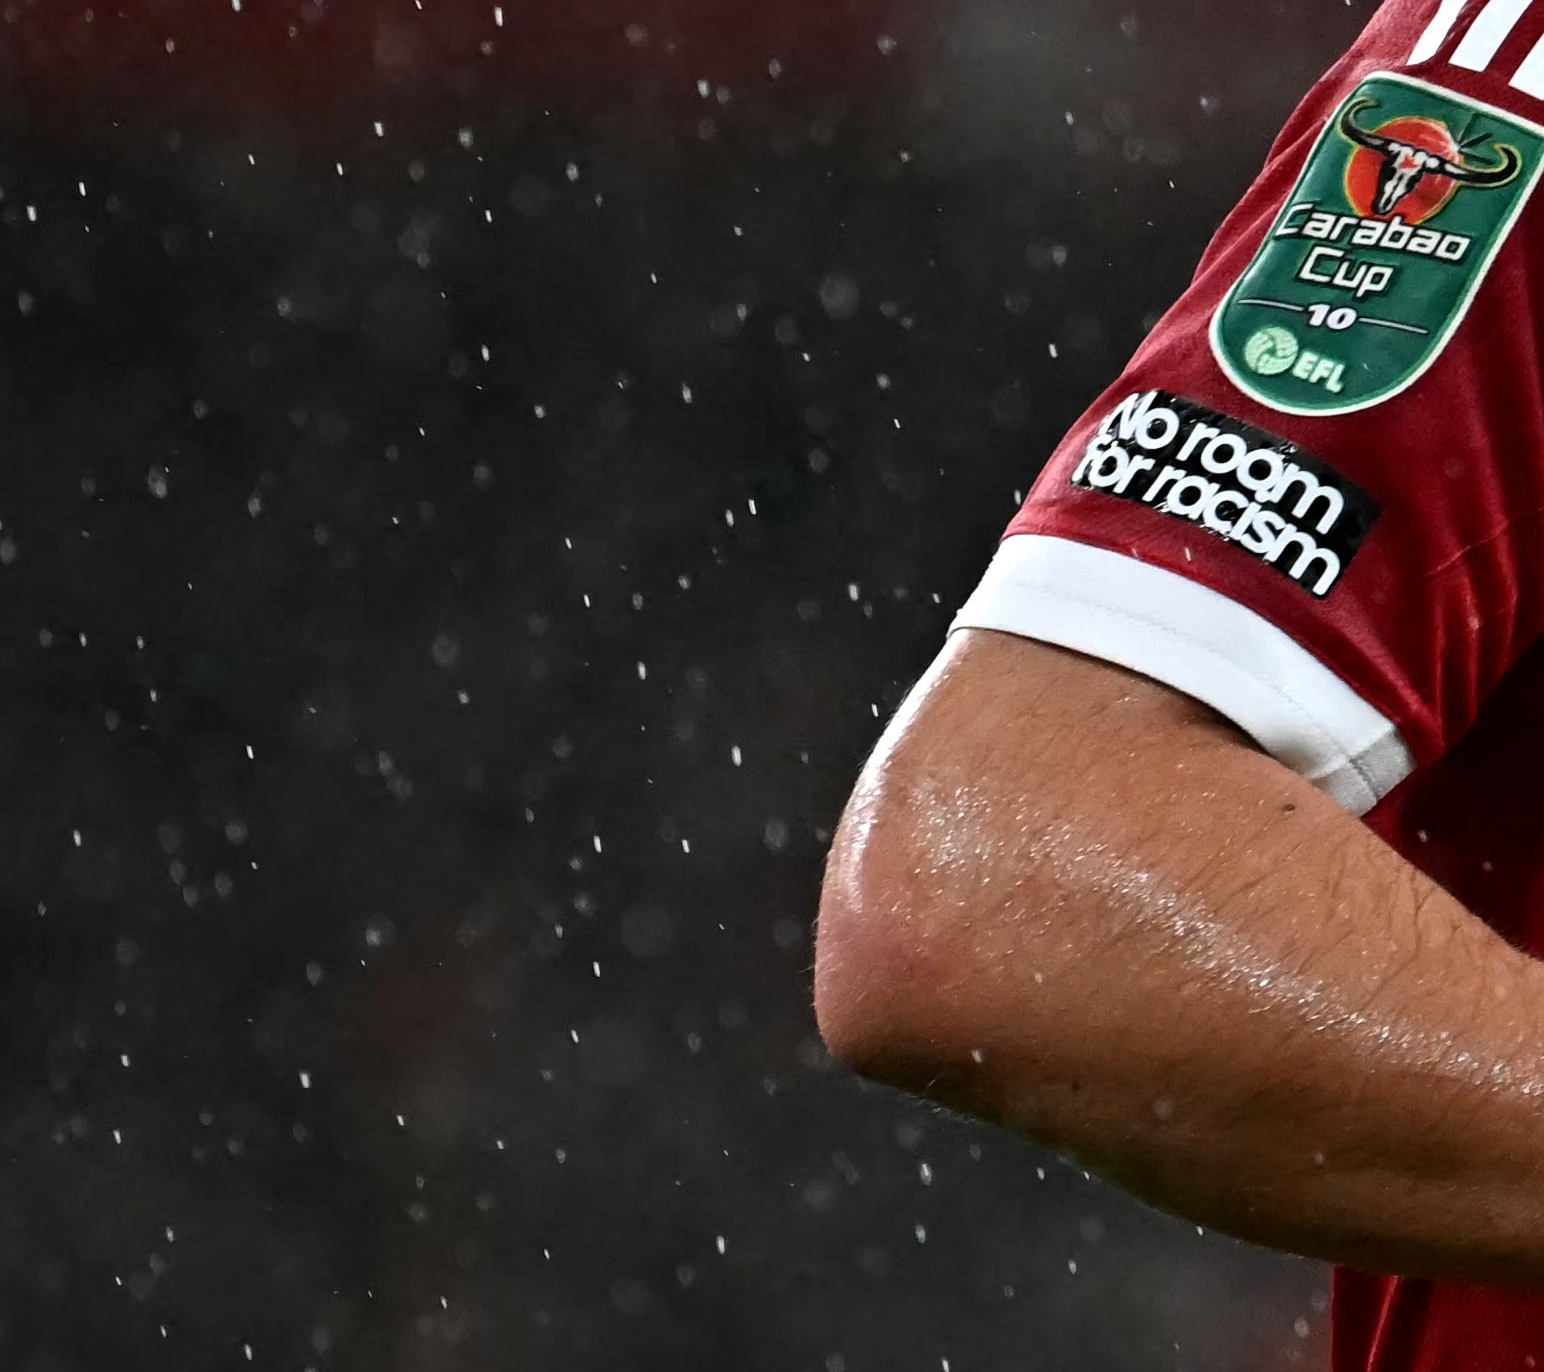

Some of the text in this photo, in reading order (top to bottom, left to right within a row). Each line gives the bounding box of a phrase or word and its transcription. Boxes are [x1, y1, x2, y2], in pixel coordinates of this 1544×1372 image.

[1276, 202, 1471, 261] Carabao
[1298, 245, 1394, 298] Cup
[1307, 303, 1357, 330] 10
[1291, 350, 1346, 393] EFL
[1098, 390, 1344, 535] No room
[1071, 433, 1341, 596] for racism
